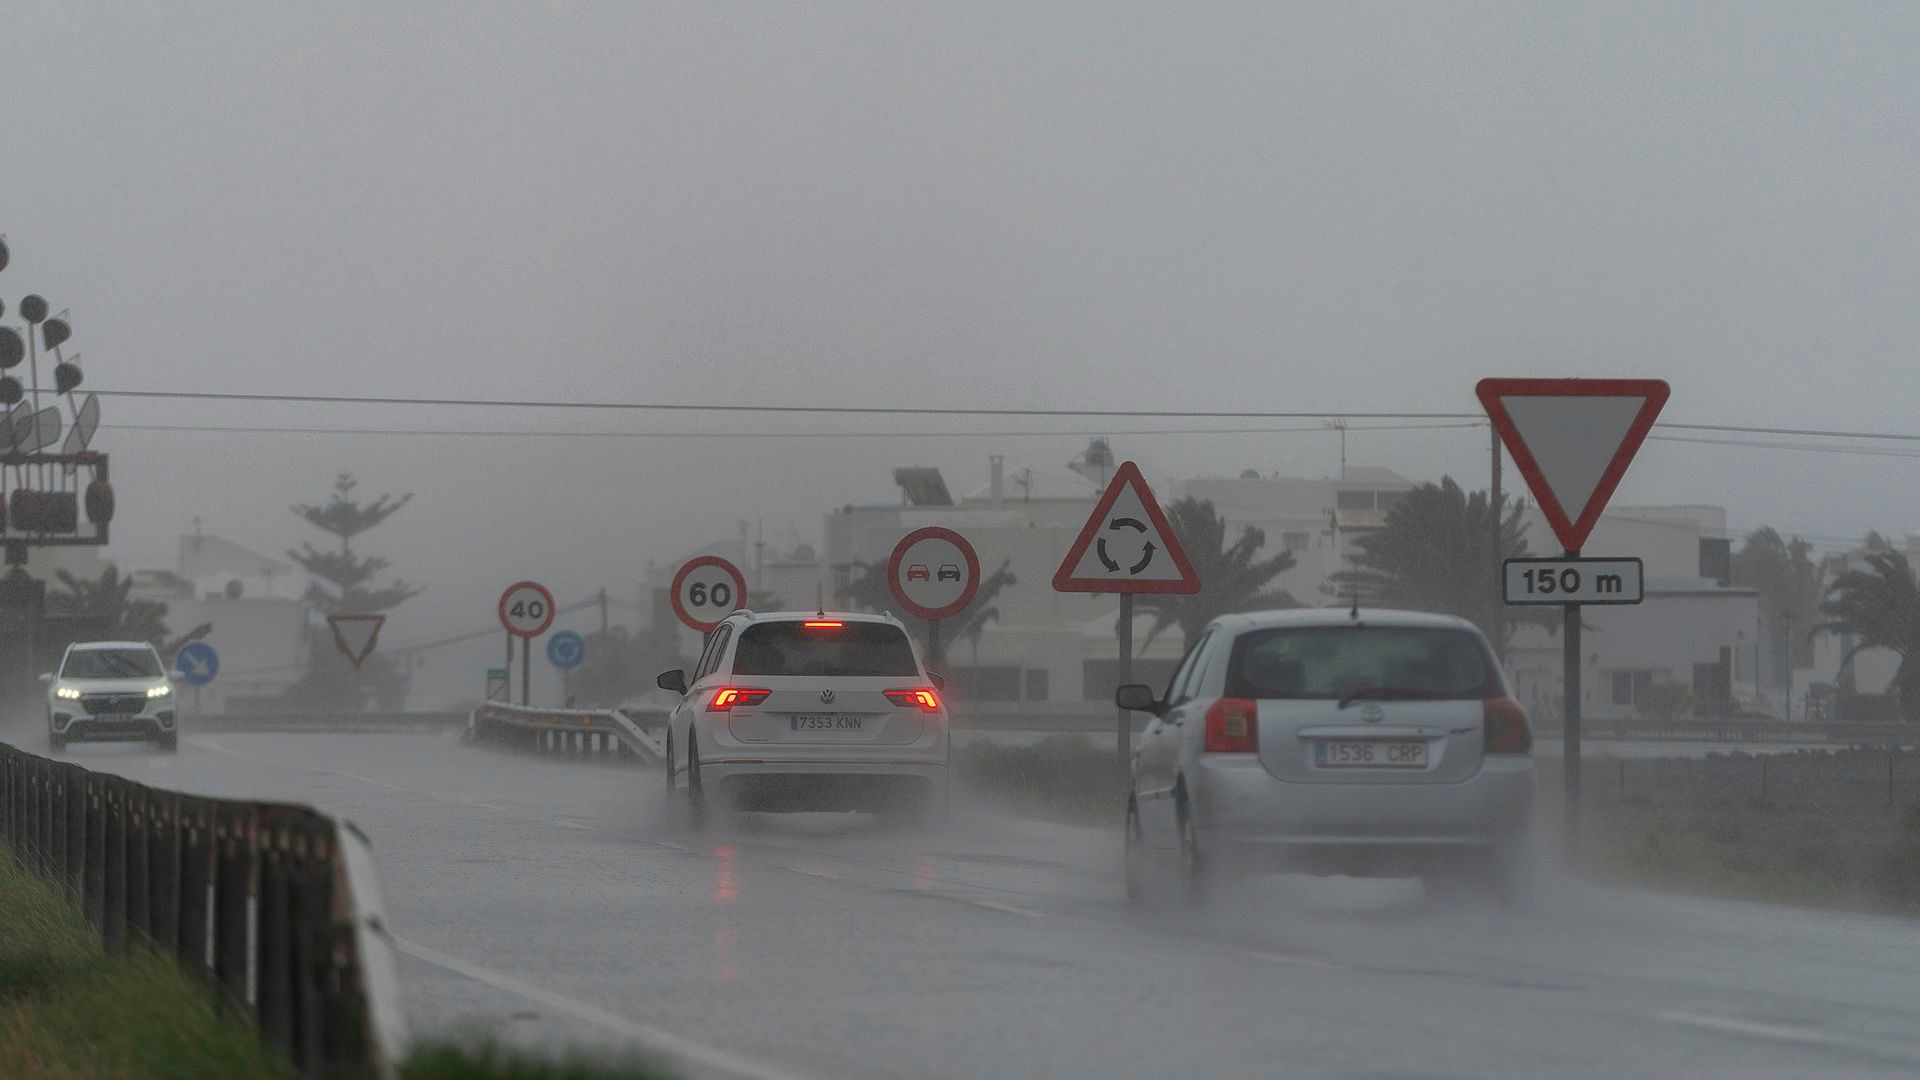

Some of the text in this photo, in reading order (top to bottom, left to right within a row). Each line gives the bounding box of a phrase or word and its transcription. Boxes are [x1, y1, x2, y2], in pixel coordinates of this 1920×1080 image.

[1523, 568, 1622, 594] 150 m
[690, 582, 730, 607] 60
[510, 600, 543, 619] 40
[800, 716, 861, 729] 7353 KNN
[1329, 744, 1424, 762] 1536 CRP
